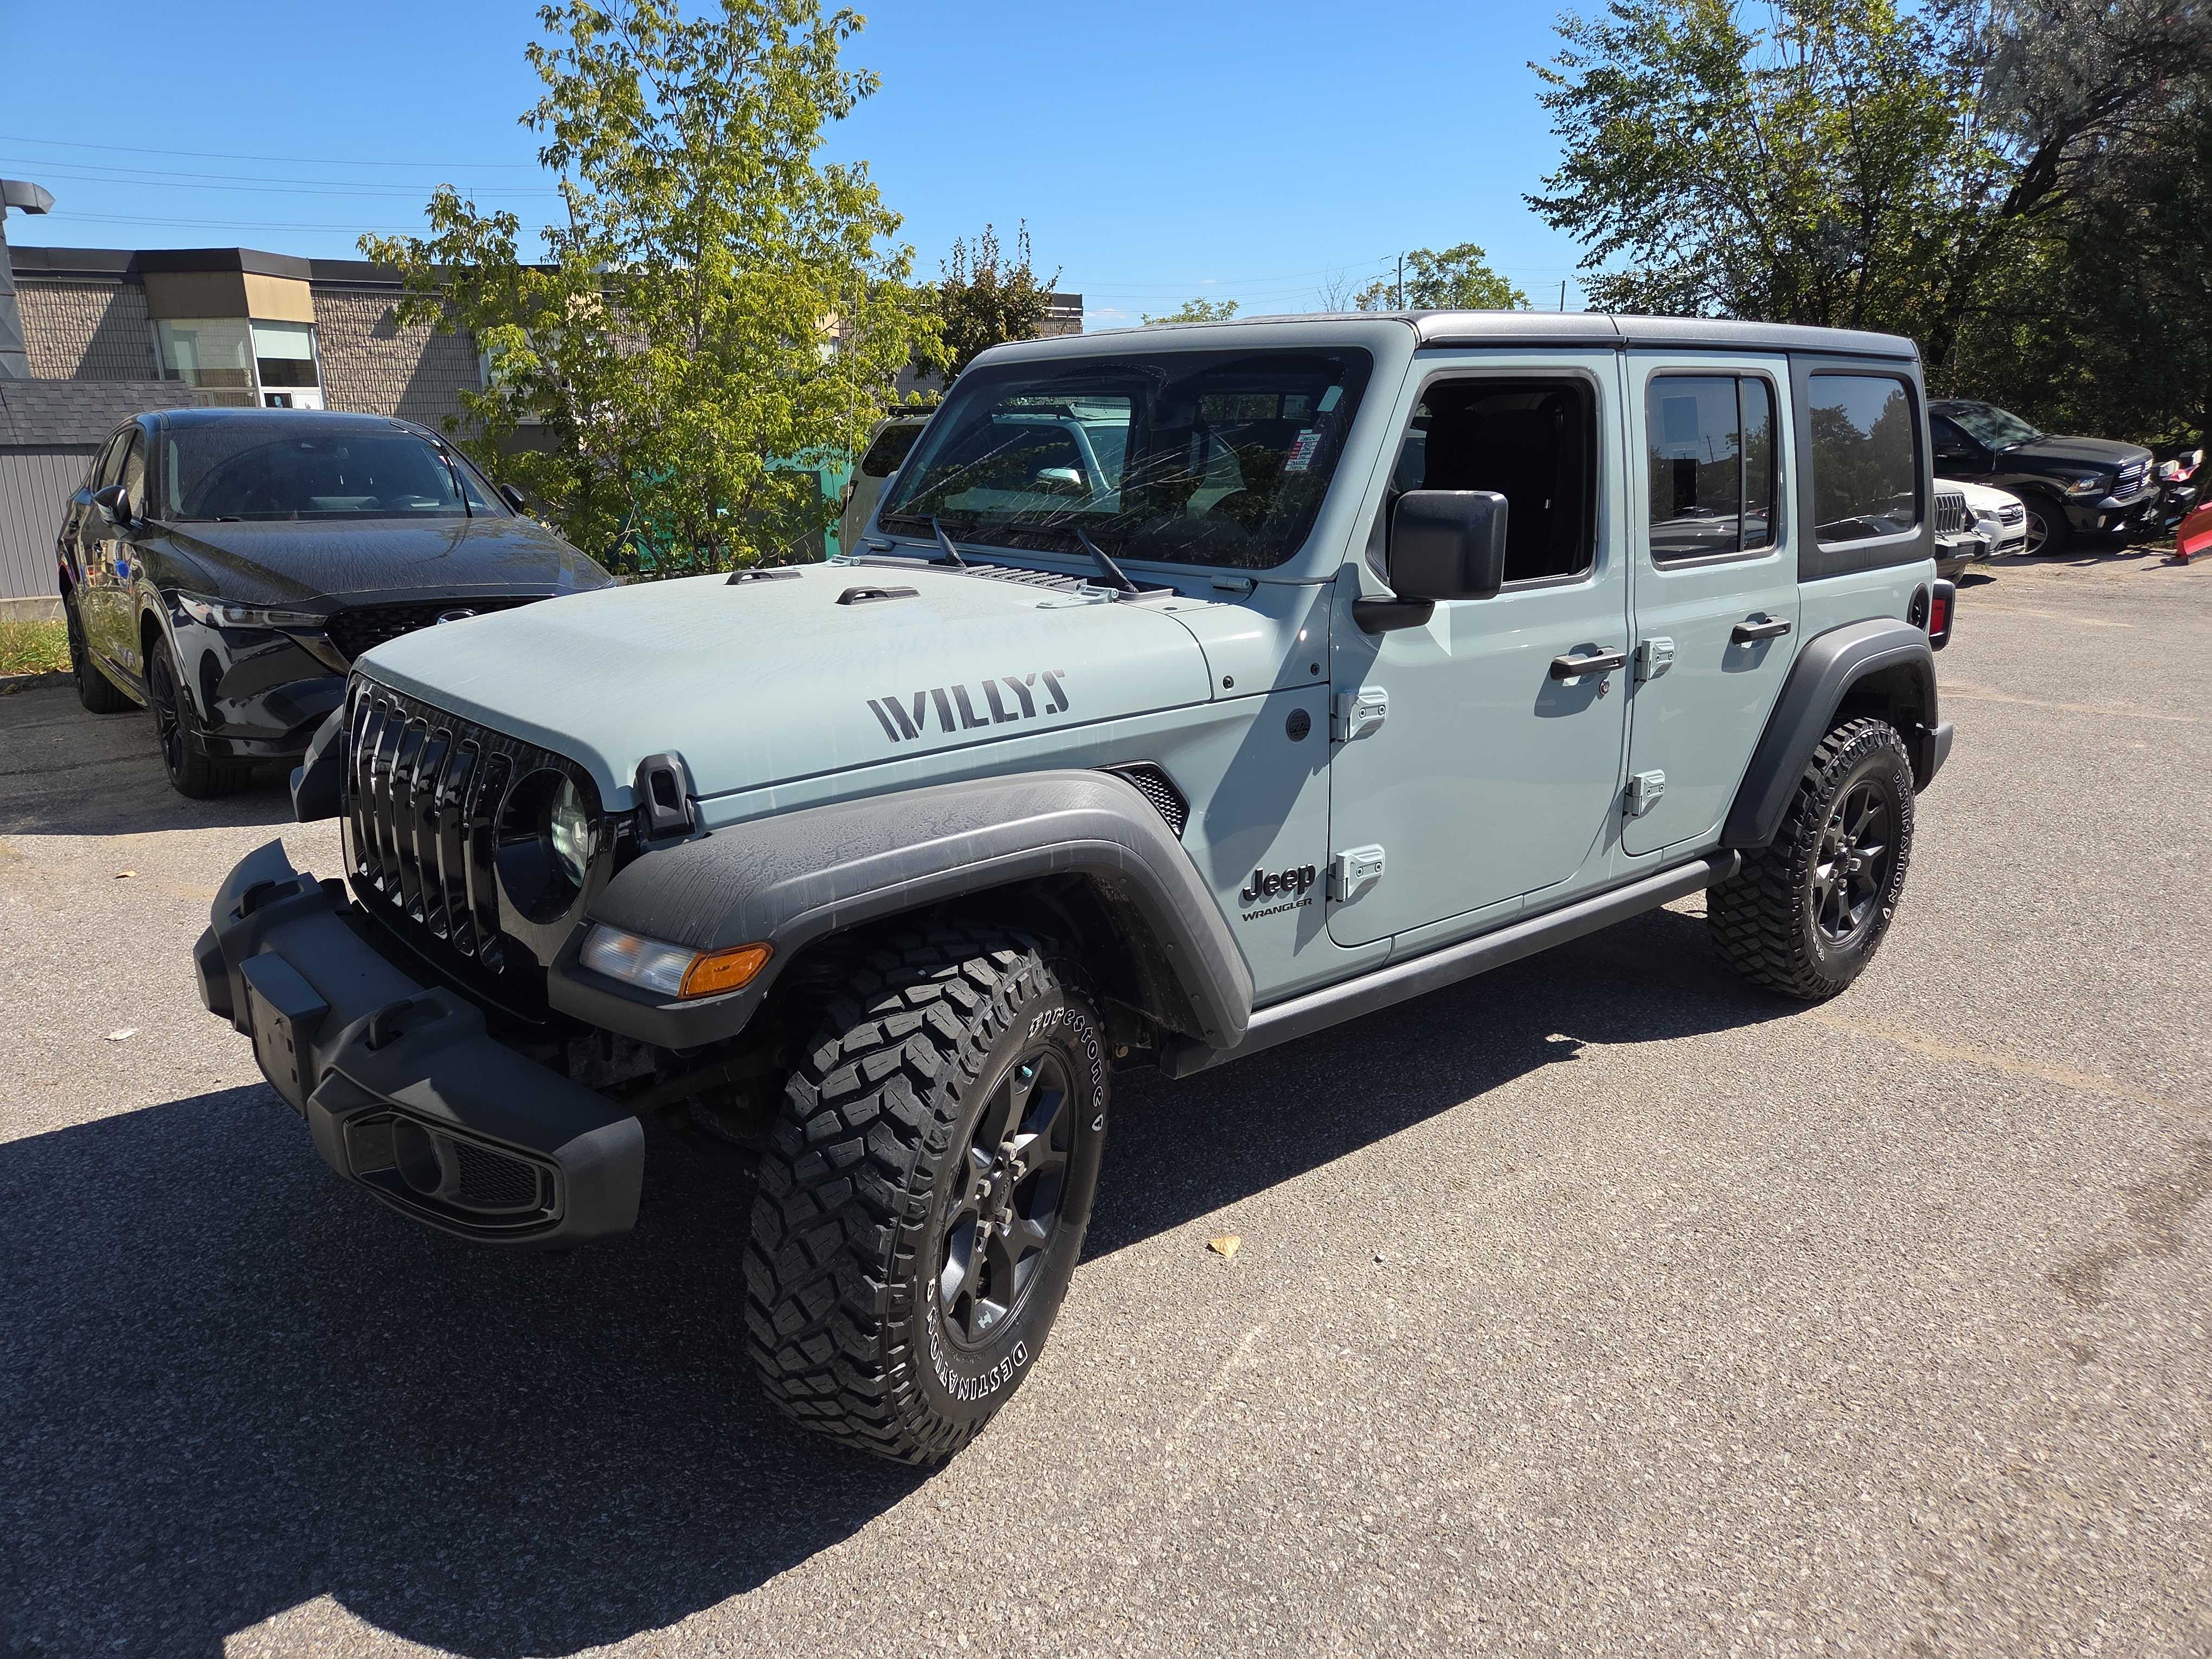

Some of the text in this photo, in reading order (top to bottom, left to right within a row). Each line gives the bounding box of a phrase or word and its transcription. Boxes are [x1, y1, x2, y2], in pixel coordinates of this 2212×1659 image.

[866, 668, 1069, 742] WILLYS
[1888, 769, 1910, 904] DESTINATION
[1242, 863, 1316, 902] Jeep
[1242, 898, 1313, 921] WRANGLER
[926, 1305, 1028, 1401] DESTINATION
